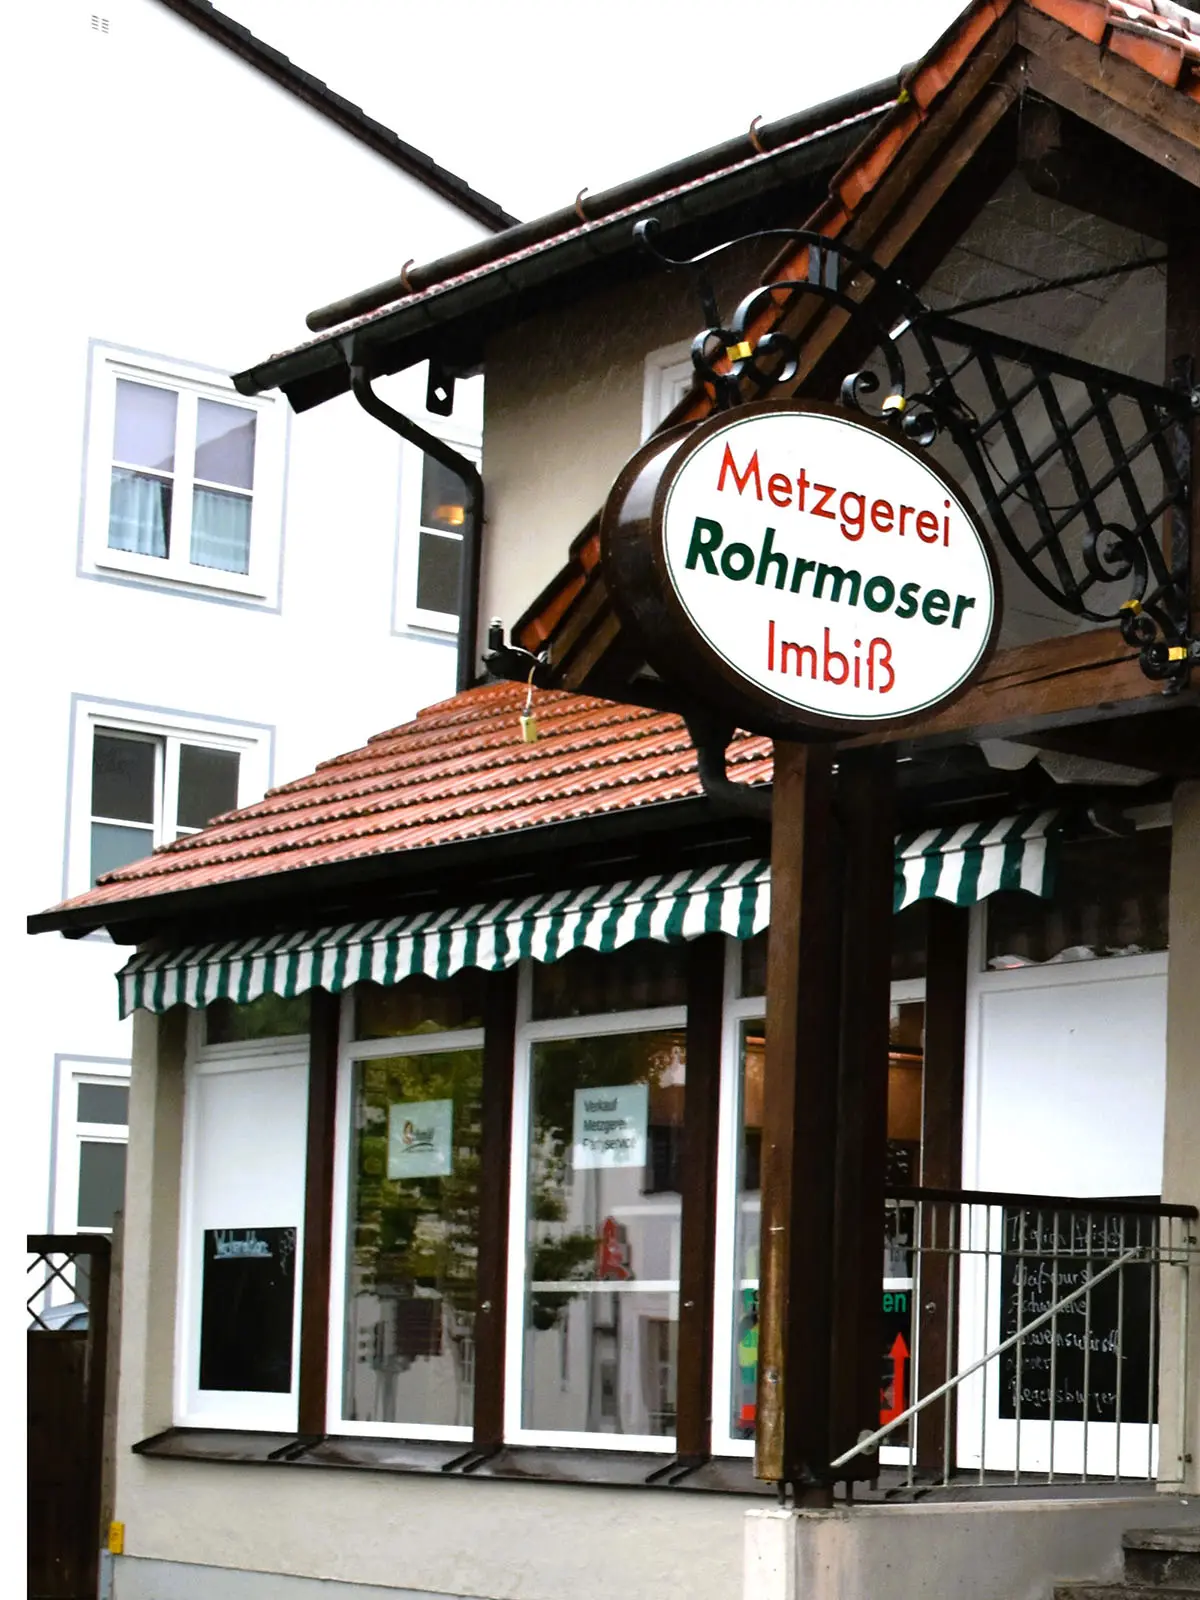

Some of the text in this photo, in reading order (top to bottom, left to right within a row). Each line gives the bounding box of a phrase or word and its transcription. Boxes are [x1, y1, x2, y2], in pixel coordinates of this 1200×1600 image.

[717, 441, 951, 547] Metzgerei
[685, 516, 975, 629] Rohrmoser
[767, 620, 895, 694] Imbiß
[583, 1098, 618, 1112] Verkauf
[583, 1119, 628, 1134] Metzgere
